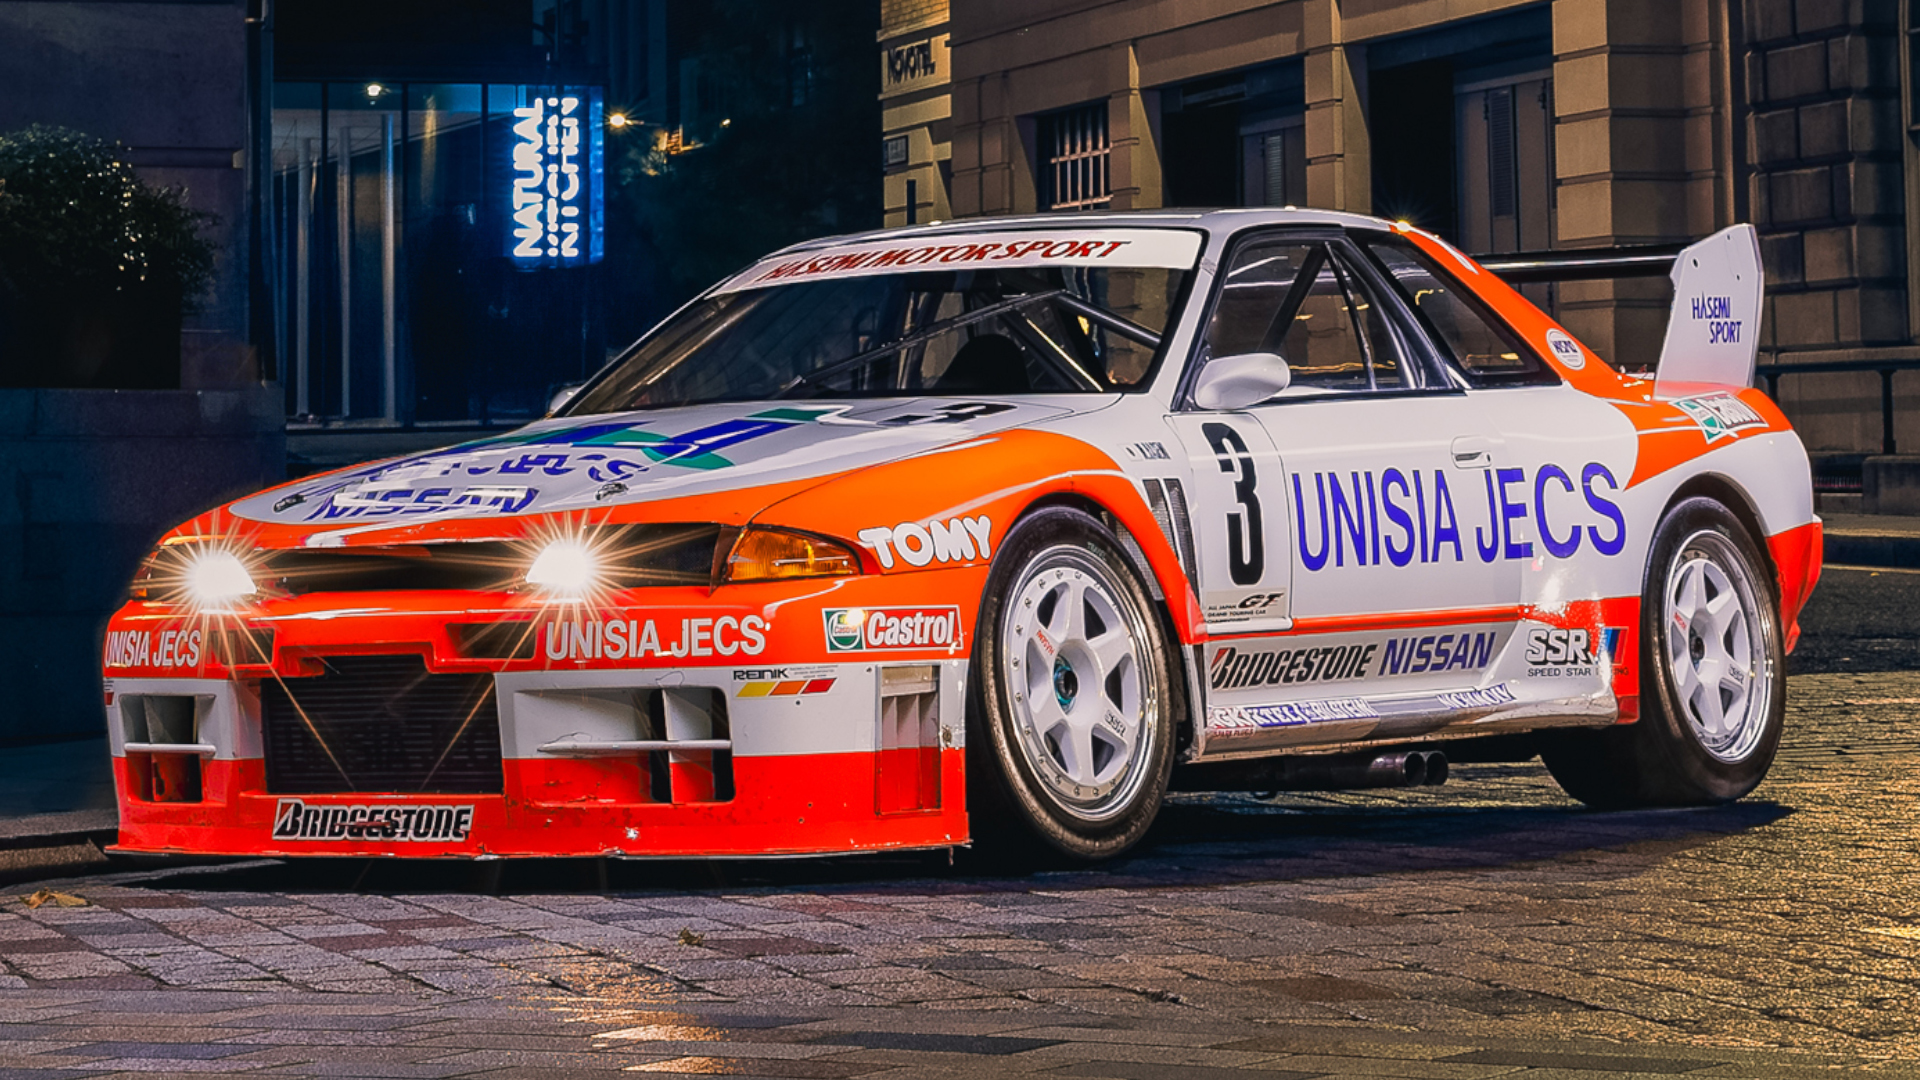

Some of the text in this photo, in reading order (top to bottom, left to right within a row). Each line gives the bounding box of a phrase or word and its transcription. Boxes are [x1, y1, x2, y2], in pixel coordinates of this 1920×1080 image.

[513, 97, 544, 257] NATURAL
[755, 251, 884, 281] HASEMI
[1691, 291, 1731, 319] HASEMI
[1709, 321, 1742, 343] SPORT
[1201, 423, 1265, 585] 3
[1292, 462, 1626, 571] UNISIA JECS
[858, 514, 992, 569] TOMY
[1238, 592, 1285, 609] GT
[546, 614, 766, 660] UNISIA JECS
[867, 611, 955, 646] Castrol
[1525, 628, 1594, 666] SSR
[104, 629, 201, 668] UNISIA JECS
[1210, 632, 1497, 688] BRIDGESTONE NISSAN
[1528, 668, 1561, 677] SPEED
[1566, 667, 1592, 676] STAR
[272, 798, 475, 842] BRIDGESTONE
